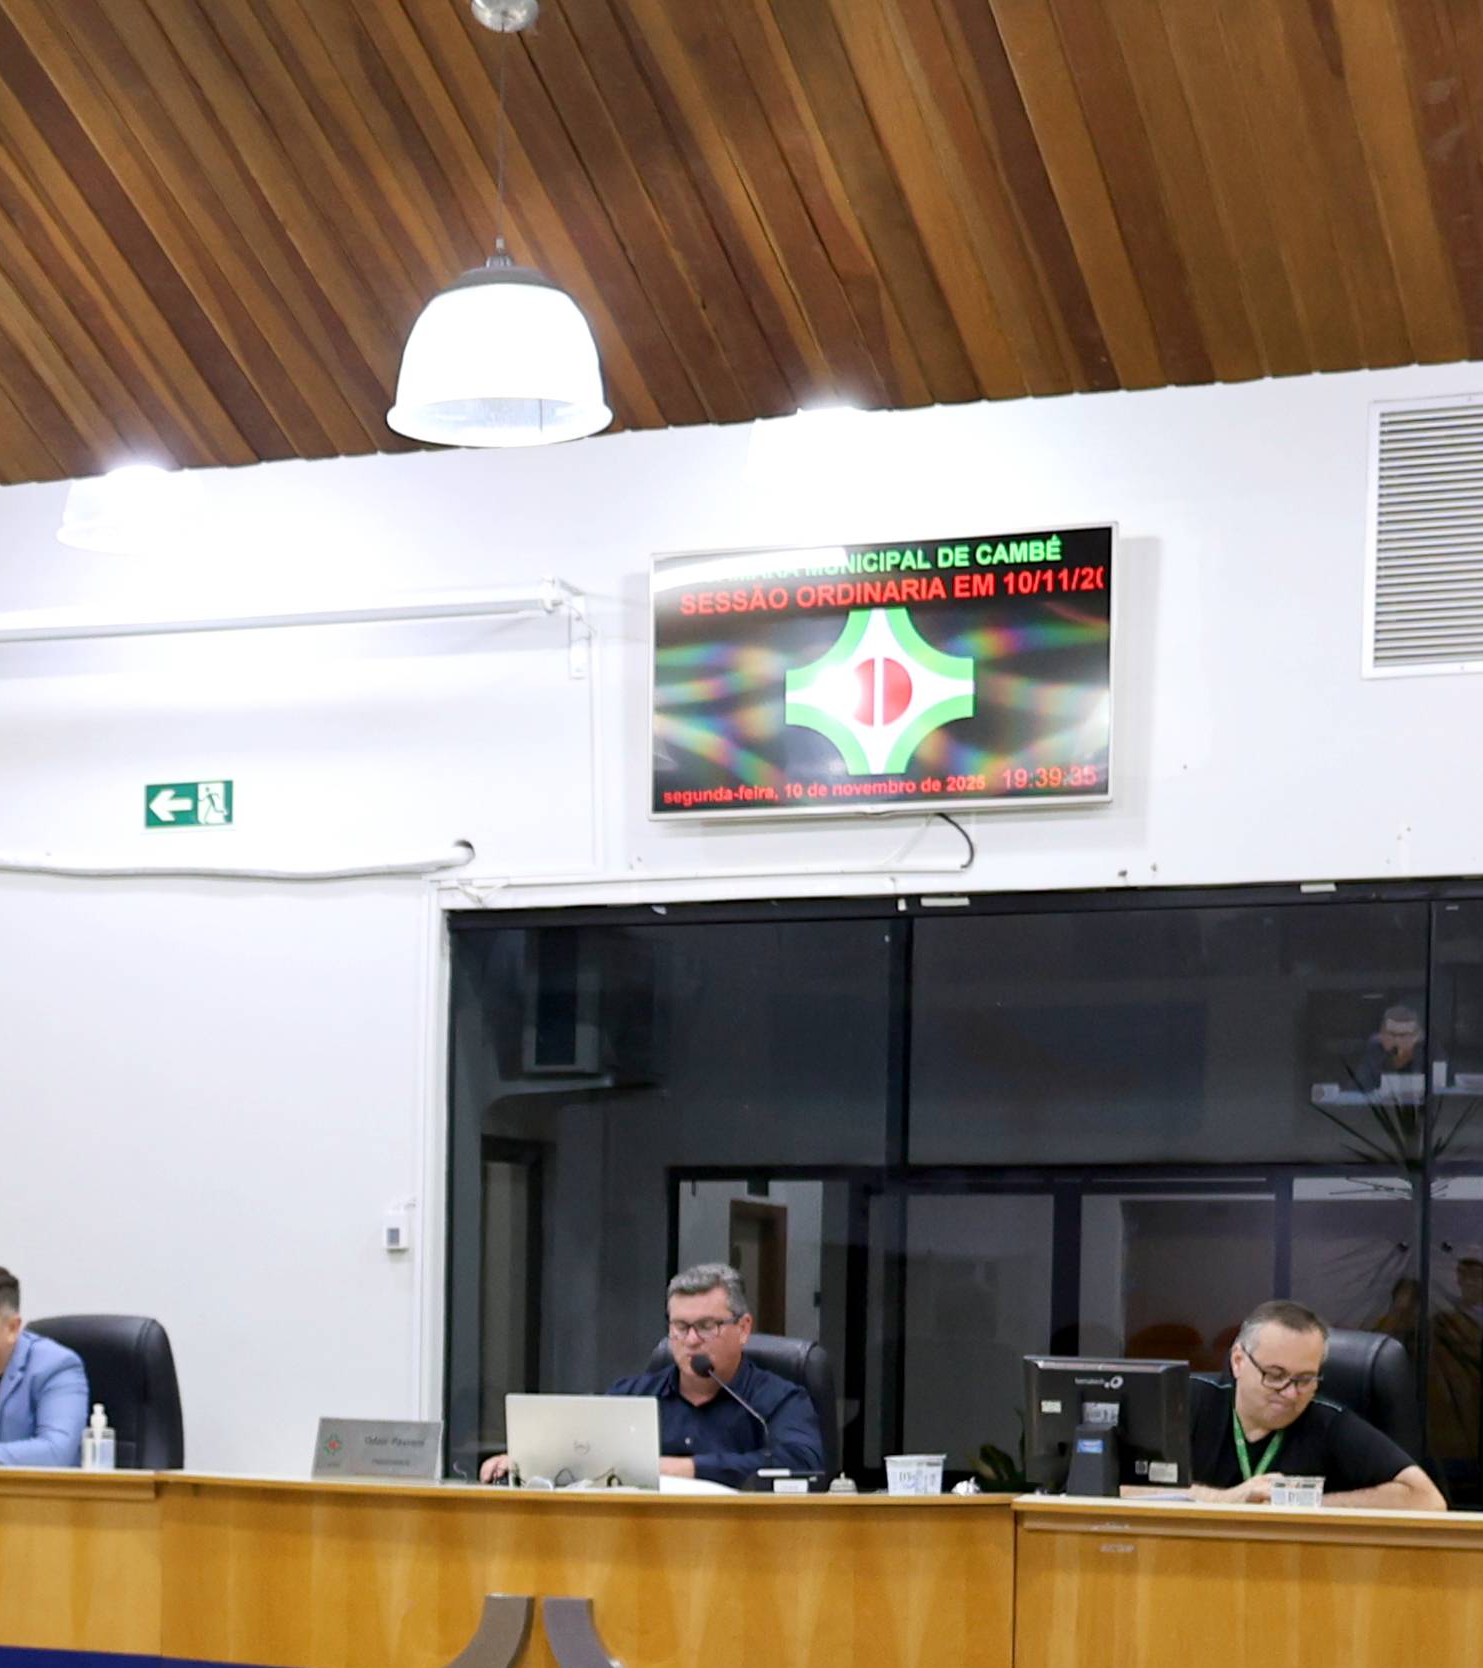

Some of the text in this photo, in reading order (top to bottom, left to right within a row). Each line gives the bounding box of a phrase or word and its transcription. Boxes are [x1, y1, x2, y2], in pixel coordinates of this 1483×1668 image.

[938, 545, 970, 568] DE
[975, 534, 1063, 566] CAMBÉ
[680, 584, 788, 615] SESSÃO
[796, 576, 947, 609] ORDINARIA
[954, 573, 996, 598] EM
[662, 784, 779, 807] segunda-feira,
[785, 783, 803, 798] 10
[807, 783, 828, 797] de
[832, 777, 916, 797] novembro
[920, 776, 942, 793] de
